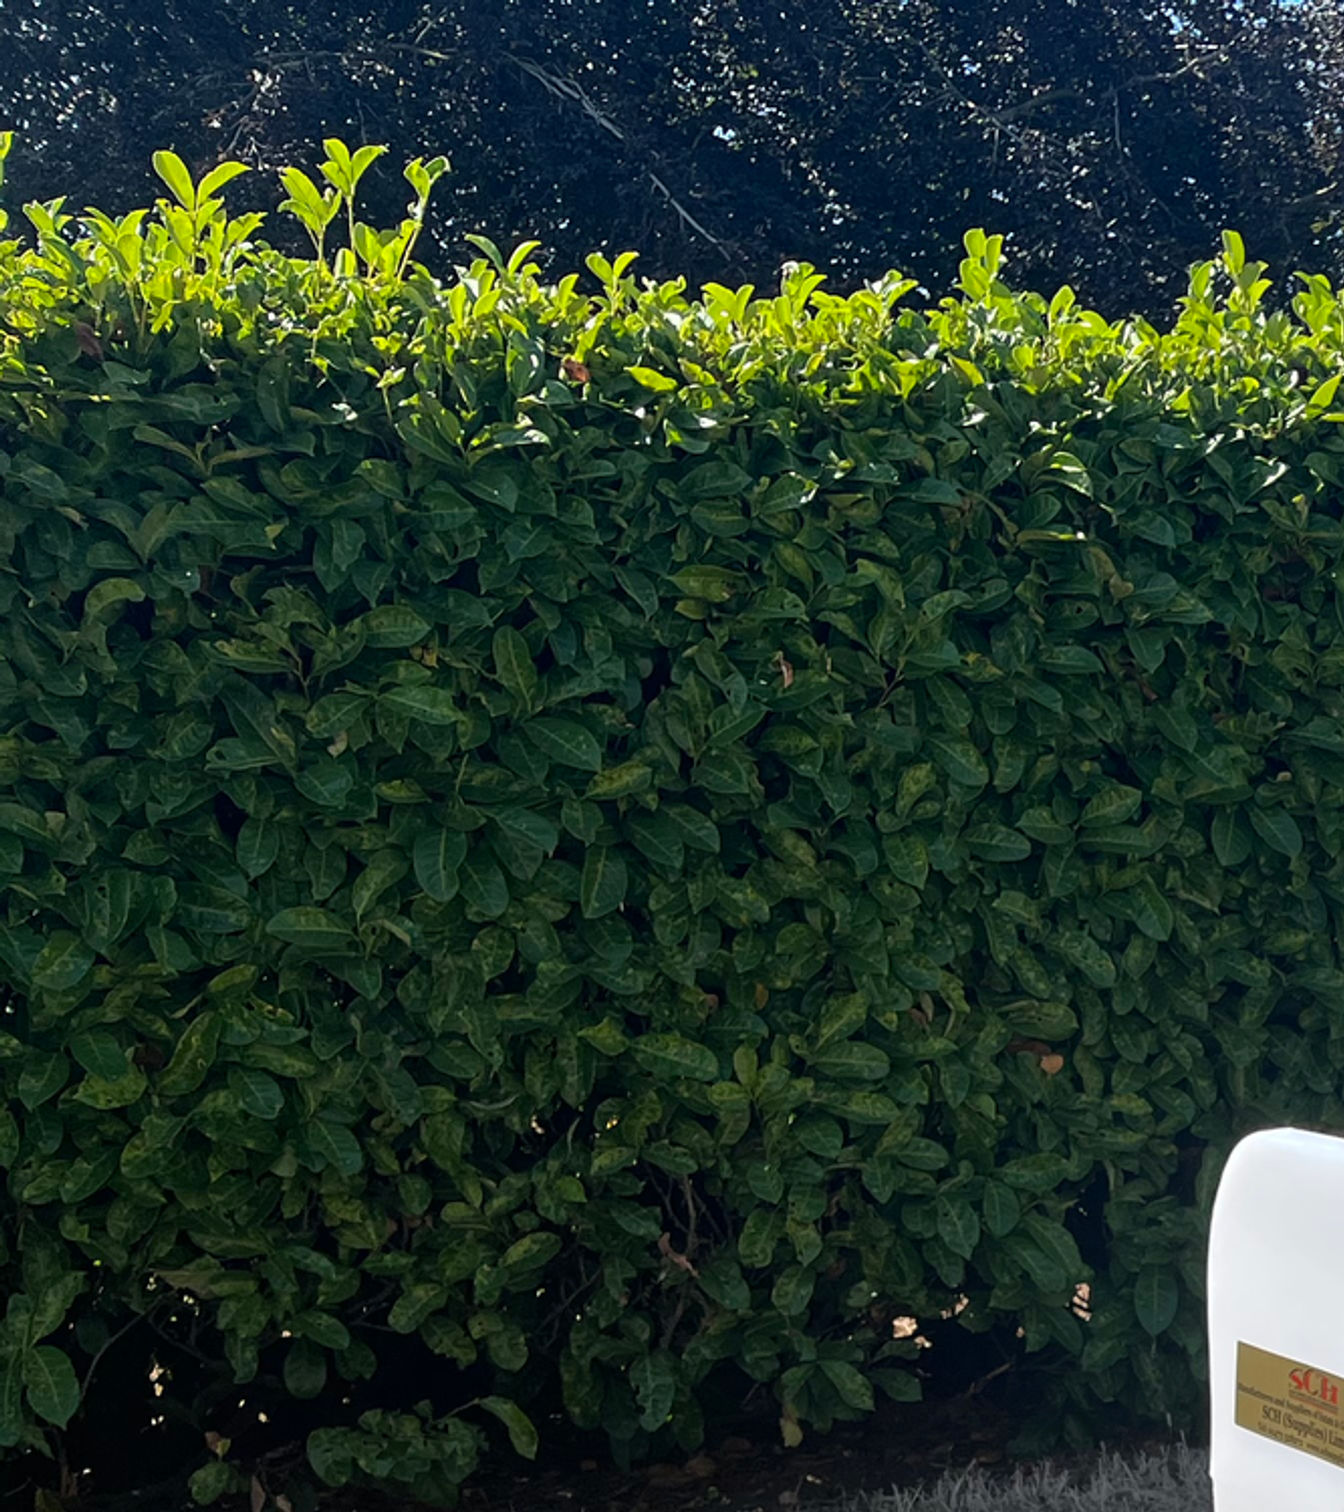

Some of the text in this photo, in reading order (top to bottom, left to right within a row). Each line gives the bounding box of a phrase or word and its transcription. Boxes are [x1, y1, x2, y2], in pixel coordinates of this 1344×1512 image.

[1289, 1367, 1340, 1406] SCH
[1262, 1404, 1282, 1424] SCH
[1283, 1410, 1328, 1444] (Supplies)
